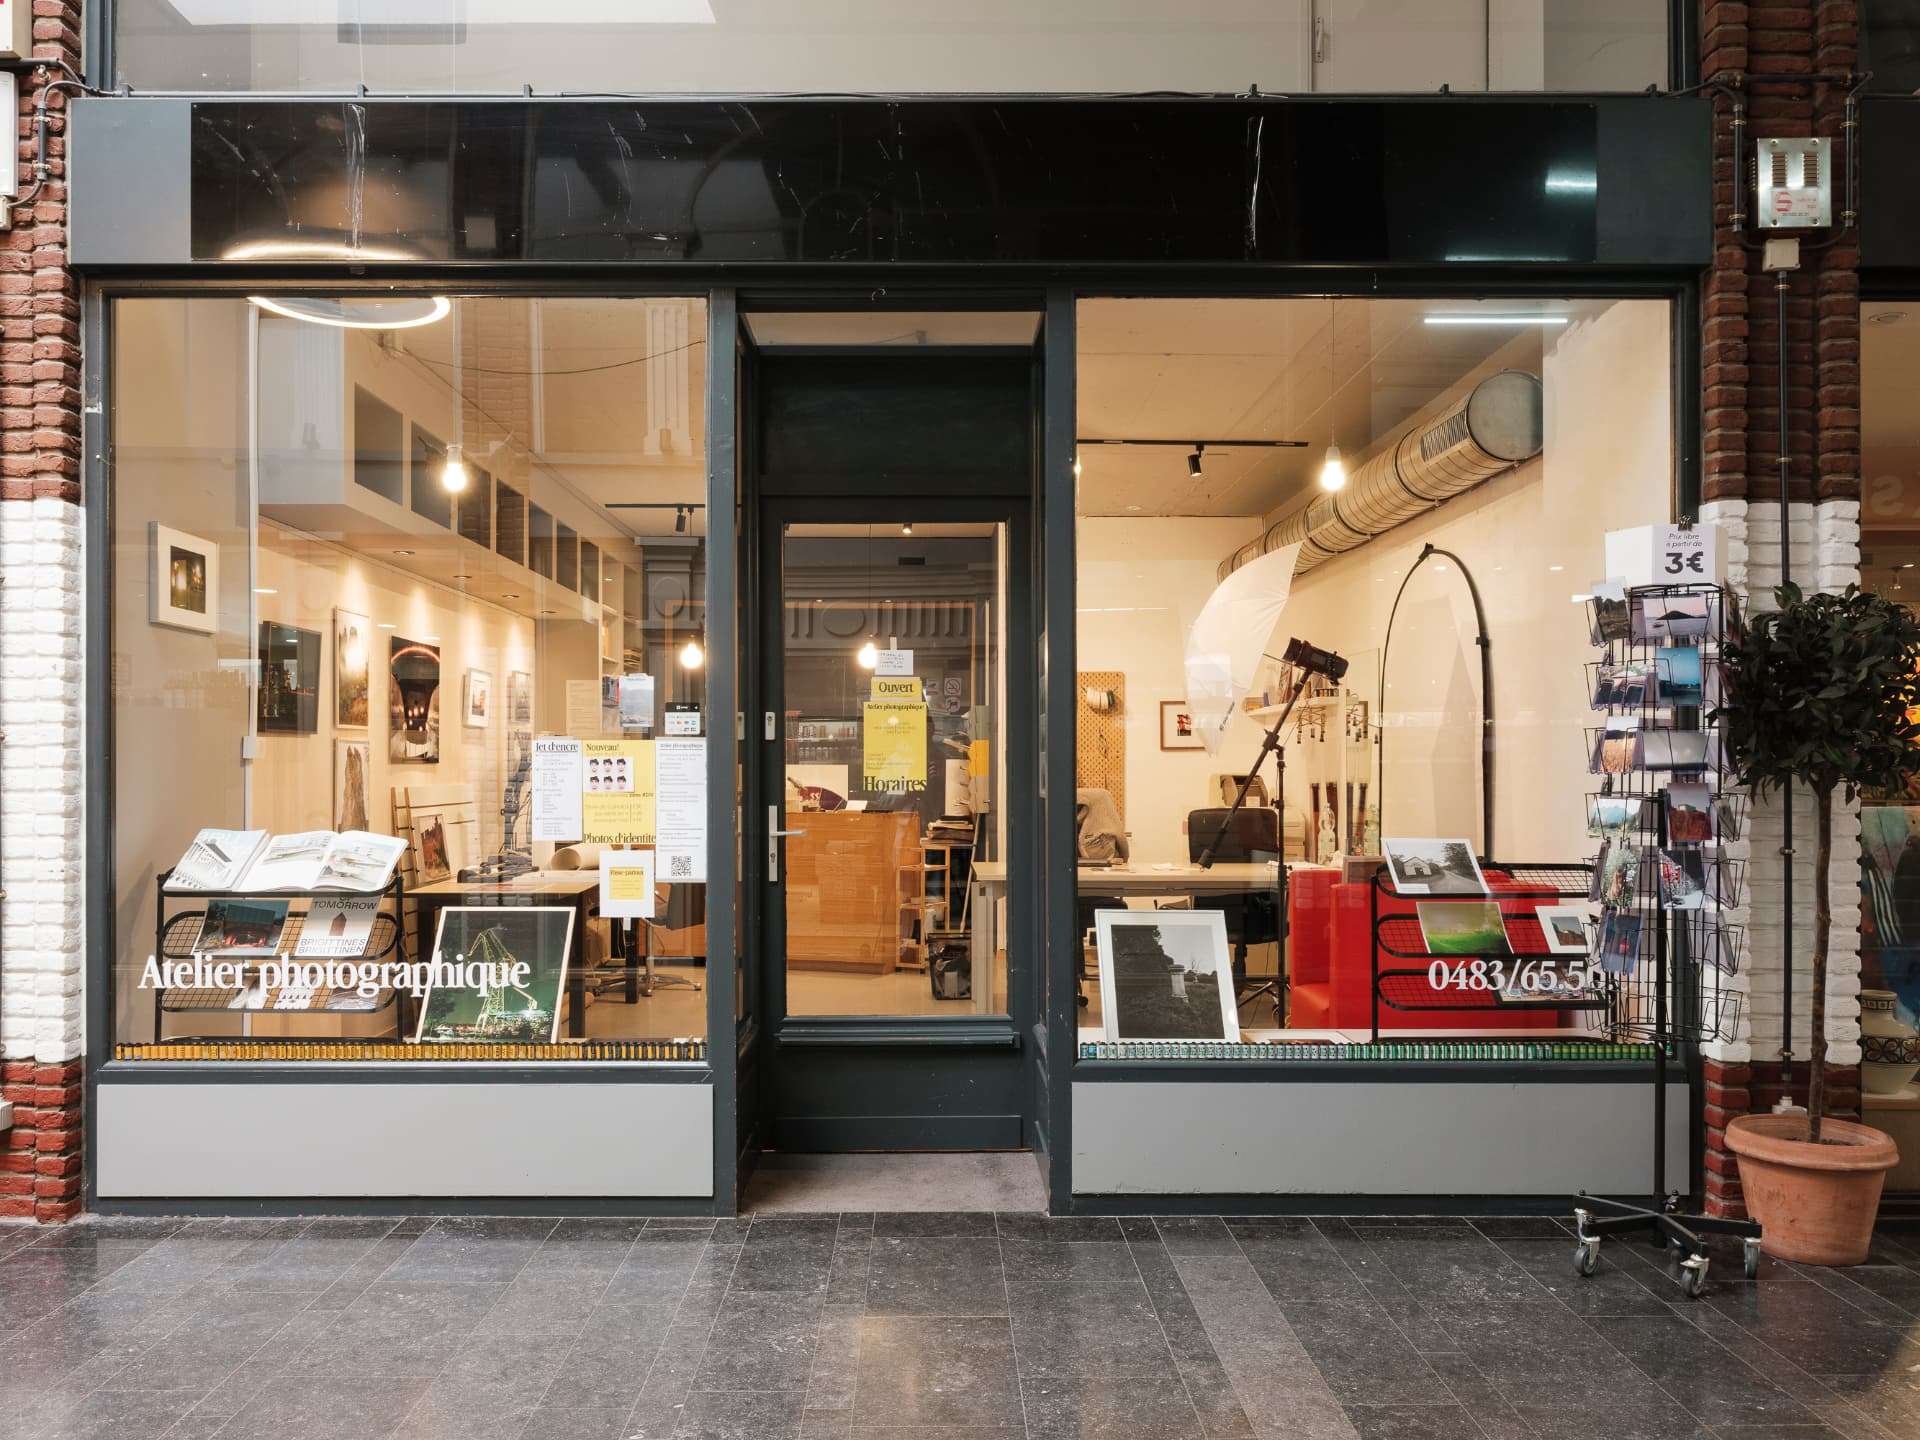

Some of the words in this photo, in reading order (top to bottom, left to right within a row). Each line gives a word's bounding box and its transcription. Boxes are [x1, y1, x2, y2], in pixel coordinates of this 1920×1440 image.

[1669, 532, 1682, 540] Prix
[1683, 532, 1700, 540] libre
[1664, 550, 1704, 575] 3€
[878, 681, 914, 693] Ouvert
[863, 775, 928, 792] Horaires
[583, 832, 613, 844] Photos
[313, 900, 378, 910] TOMORROW
[300, 938, 367, 947] BRIGITTINES
[137, 952, 250, 990] Atelier
[258, 951, 531, 998] photographique
